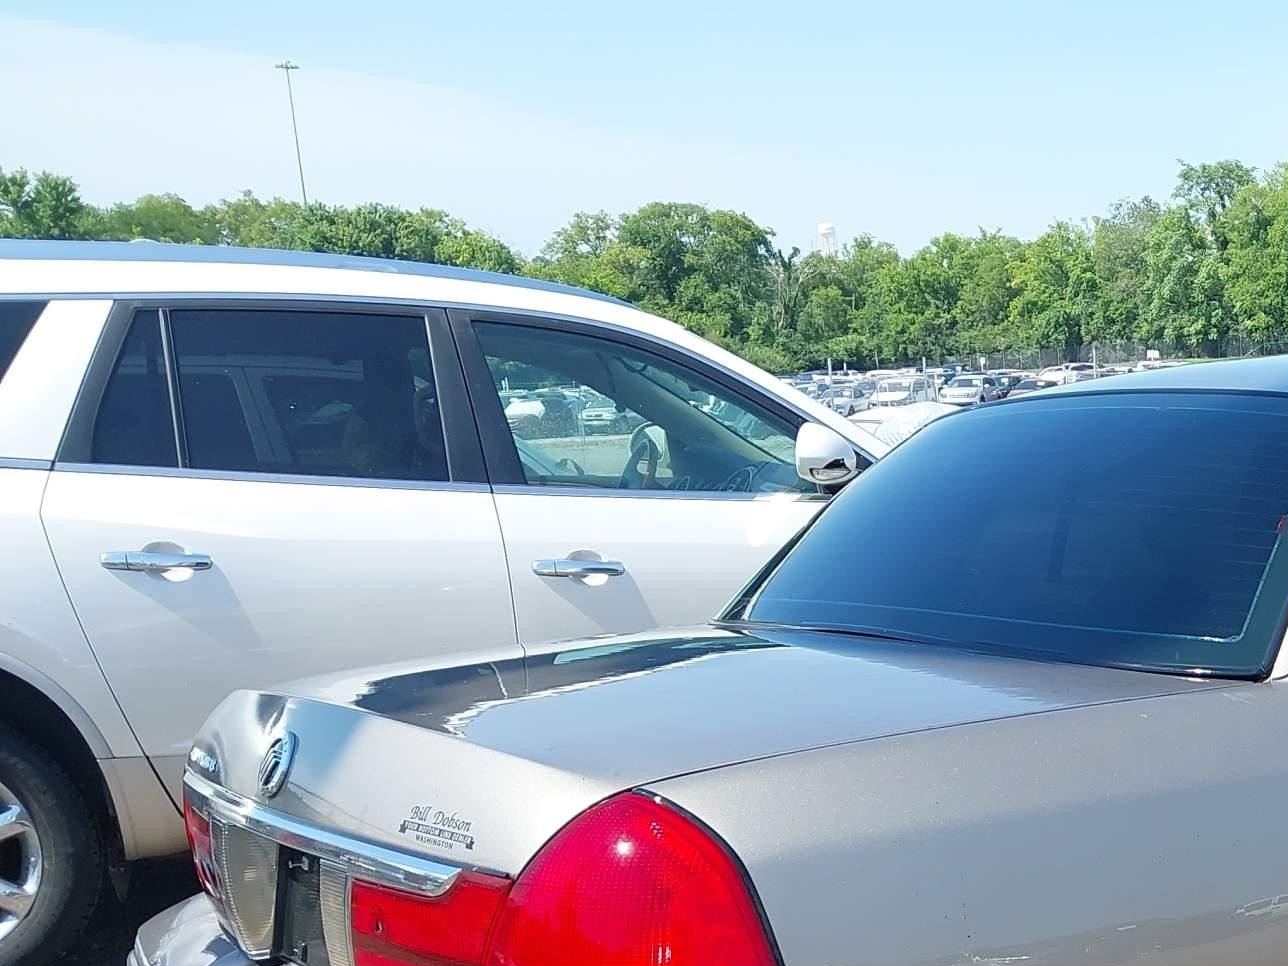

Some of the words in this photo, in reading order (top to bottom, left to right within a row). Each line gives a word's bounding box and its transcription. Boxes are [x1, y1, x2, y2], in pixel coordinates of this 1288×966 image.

[410, 805, 433, 822] Bill
[433, 811, 472, 832] Dobson
[416, 834, 453, 850] WASHINGTON
